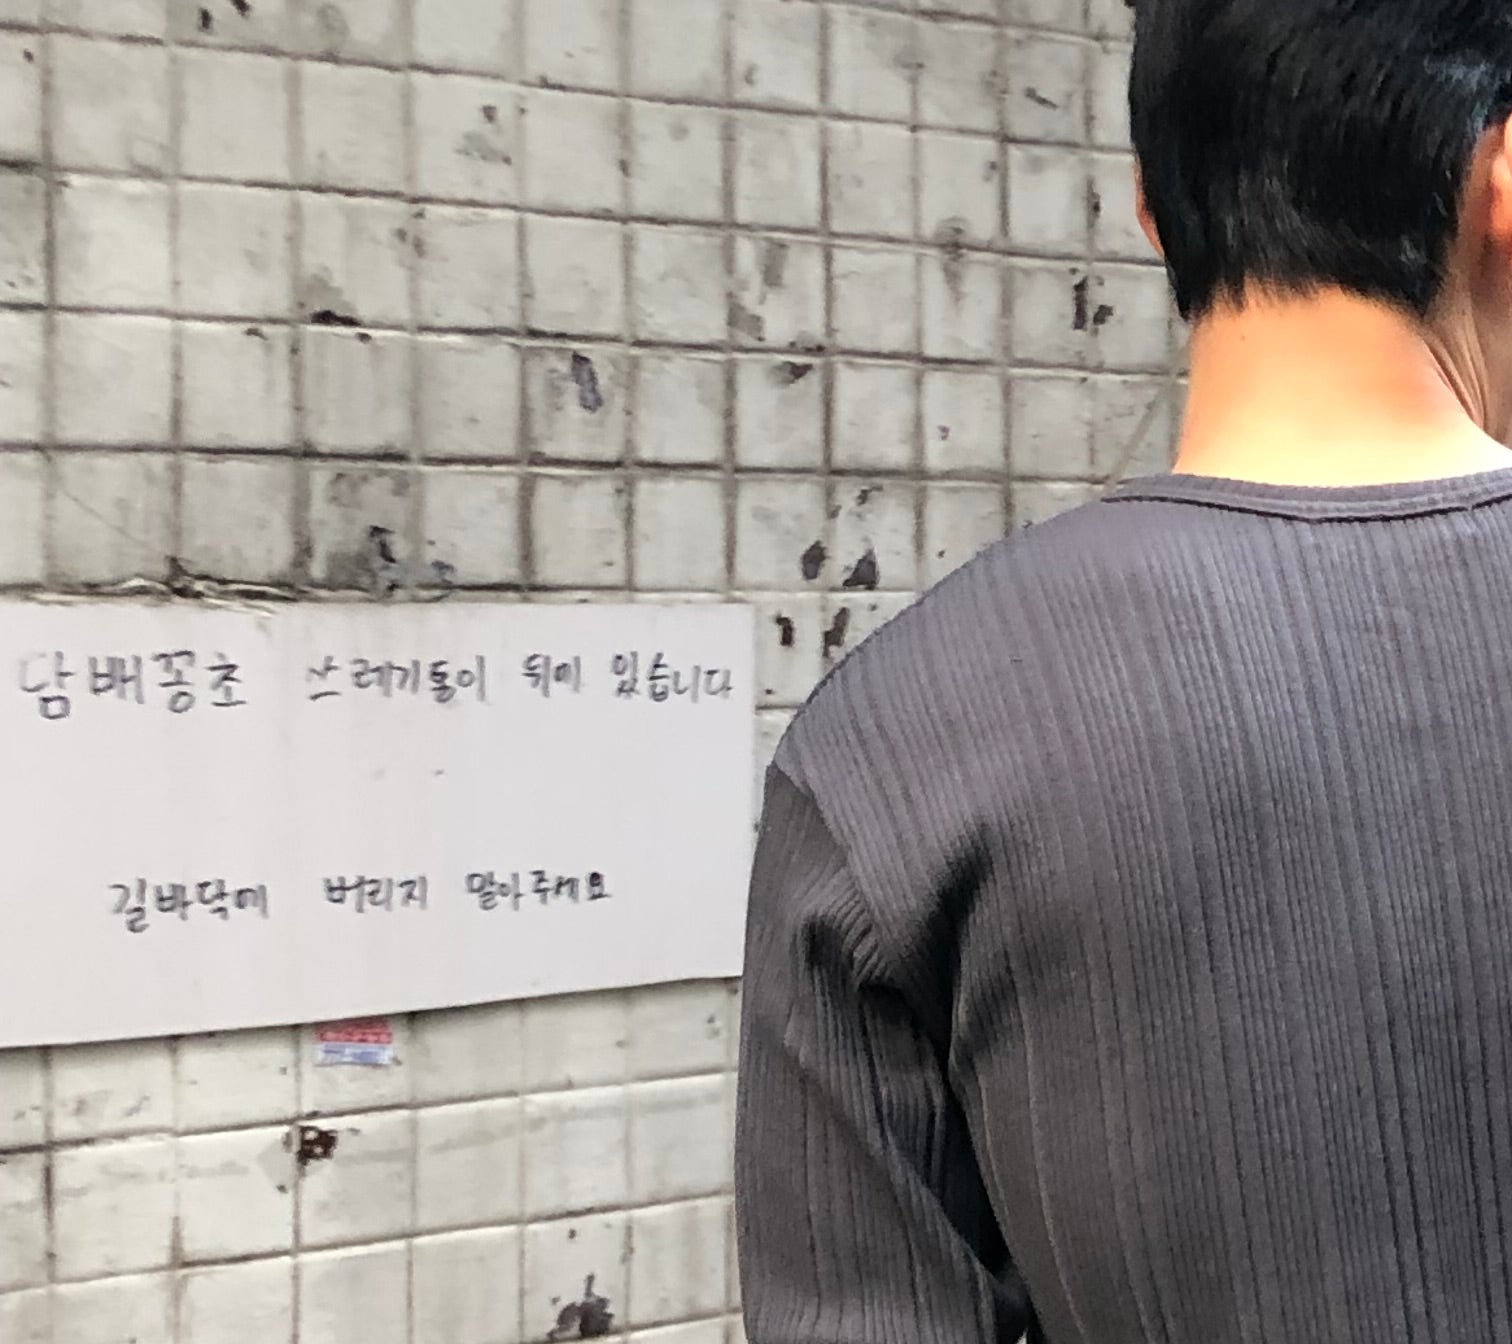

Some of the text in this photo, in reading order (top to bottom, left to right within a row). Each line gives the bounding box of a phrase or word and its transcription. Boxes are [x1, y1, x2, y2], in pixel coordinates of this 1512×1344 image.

[18, 648, 248, 721] 담배꽁초
[608, 650, 734, 704] 있습니다
[107, 868, 614, 934] 길바닥에 버리지 말아주세요
